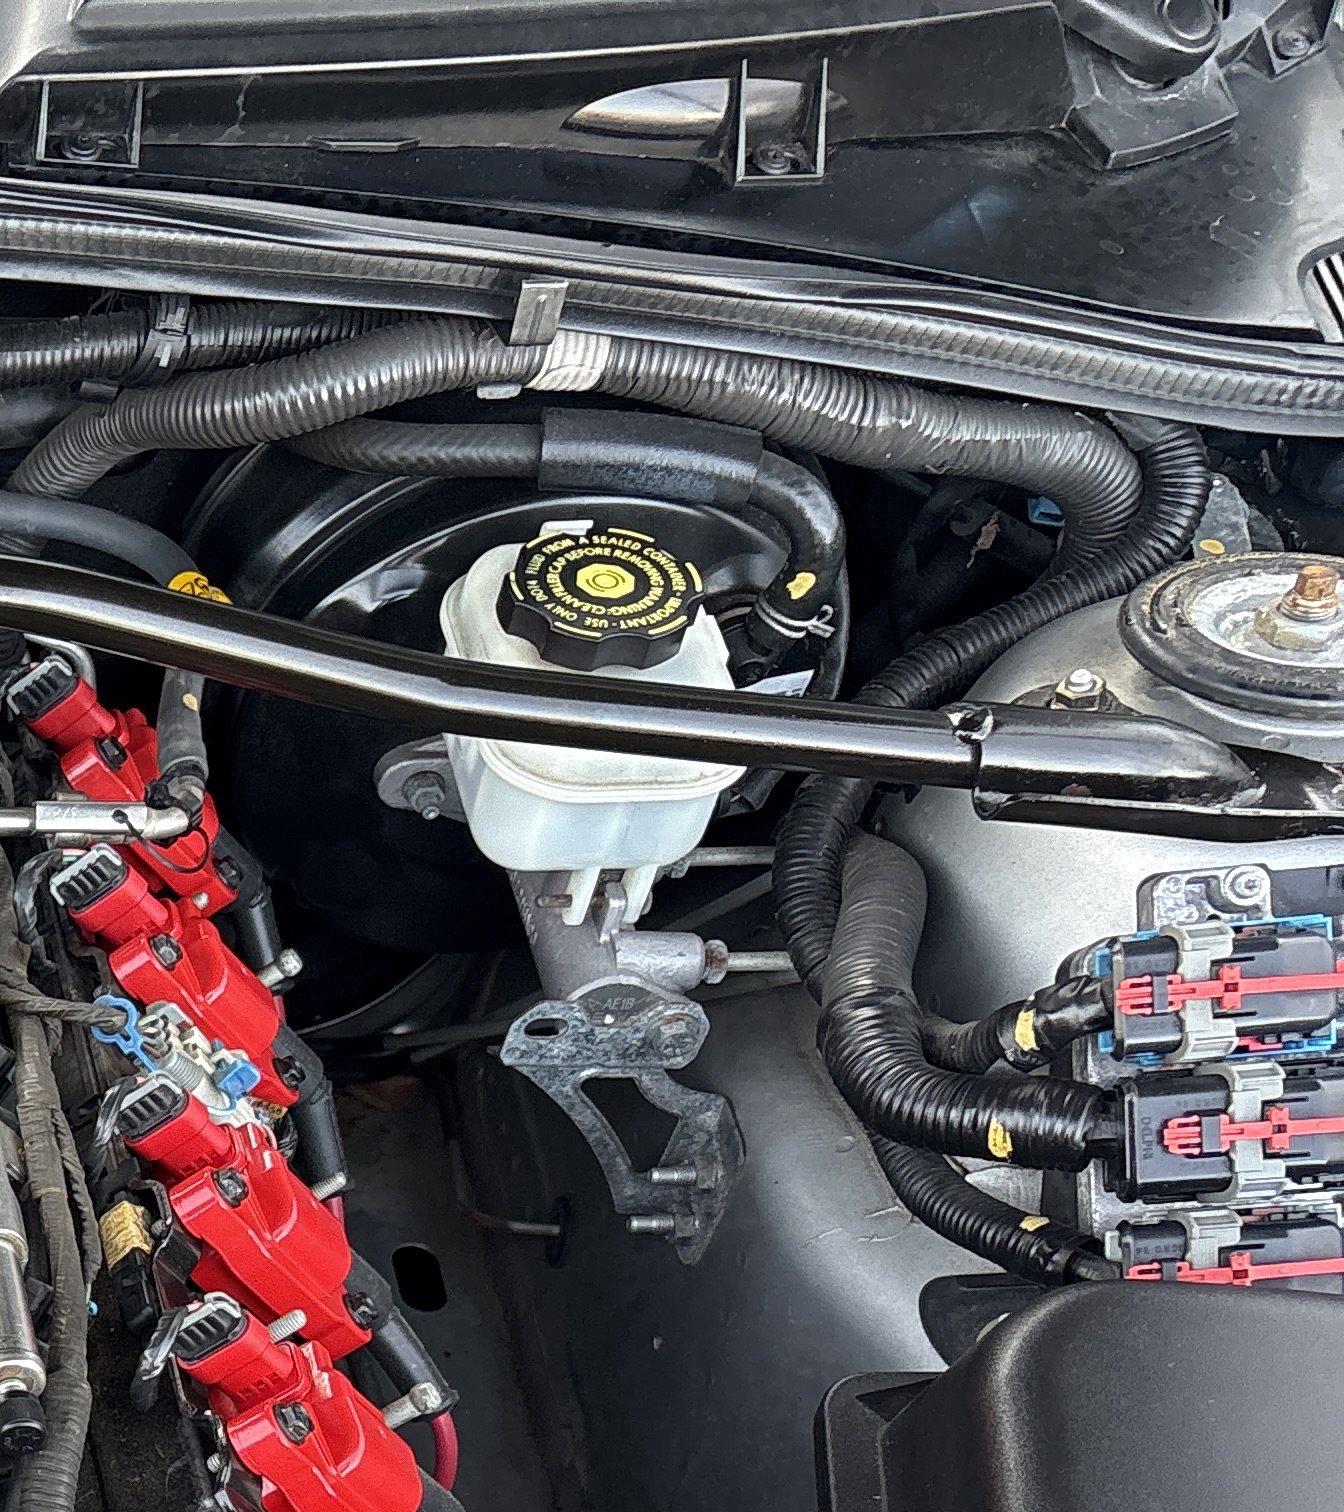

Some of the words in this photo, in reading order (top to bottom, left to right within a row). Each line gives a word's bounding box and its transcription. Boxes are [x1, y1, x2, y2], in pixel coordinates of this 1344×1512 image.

[542, 538, 575, 555] FROM
[578, 536, 590, 545] A
[592, 535, 642, 550] SEALED
[564, 548, 612, 561] BEFORE
[548, 556, 567, 574] CAP
[612, 549, 664, 585] REMOVING
[544, 602, 578, 621] ONLY
[560, 596, 606, 615] CLEAN
[583, 616, 609, 628] USE
